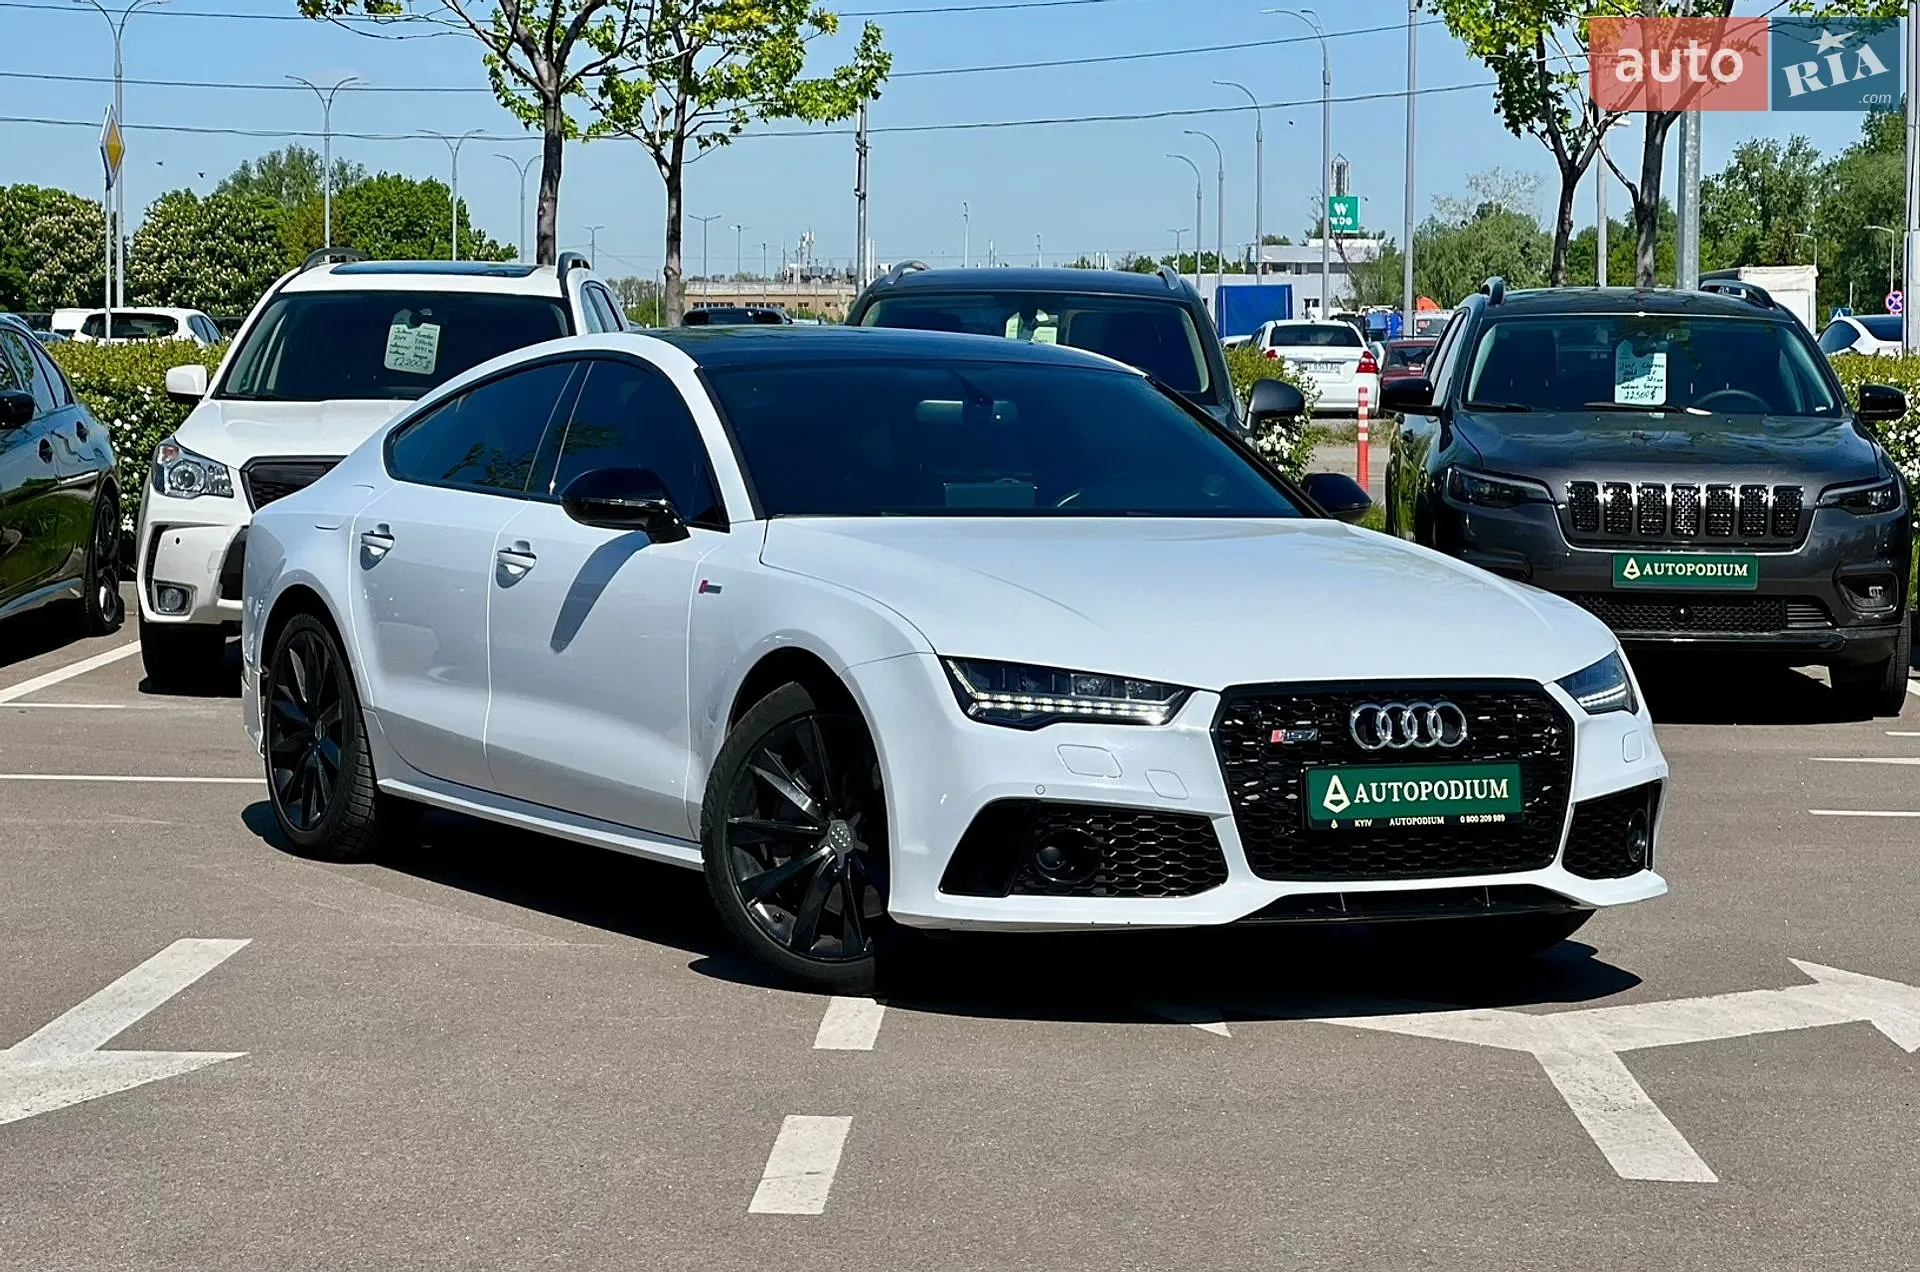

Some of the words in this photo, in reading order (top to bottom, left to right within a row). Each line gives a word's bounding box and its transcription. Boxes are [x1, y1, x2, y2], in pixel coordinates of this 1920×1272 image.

[1642, 562, 1749, 577] AUTOPODIUM
[1353, 778, 1510, 804] AUTOPODIUM
[1354, 818, 1373, 828] KYIV
[1389, 816, 1445, 826] AUTOPODIUM
